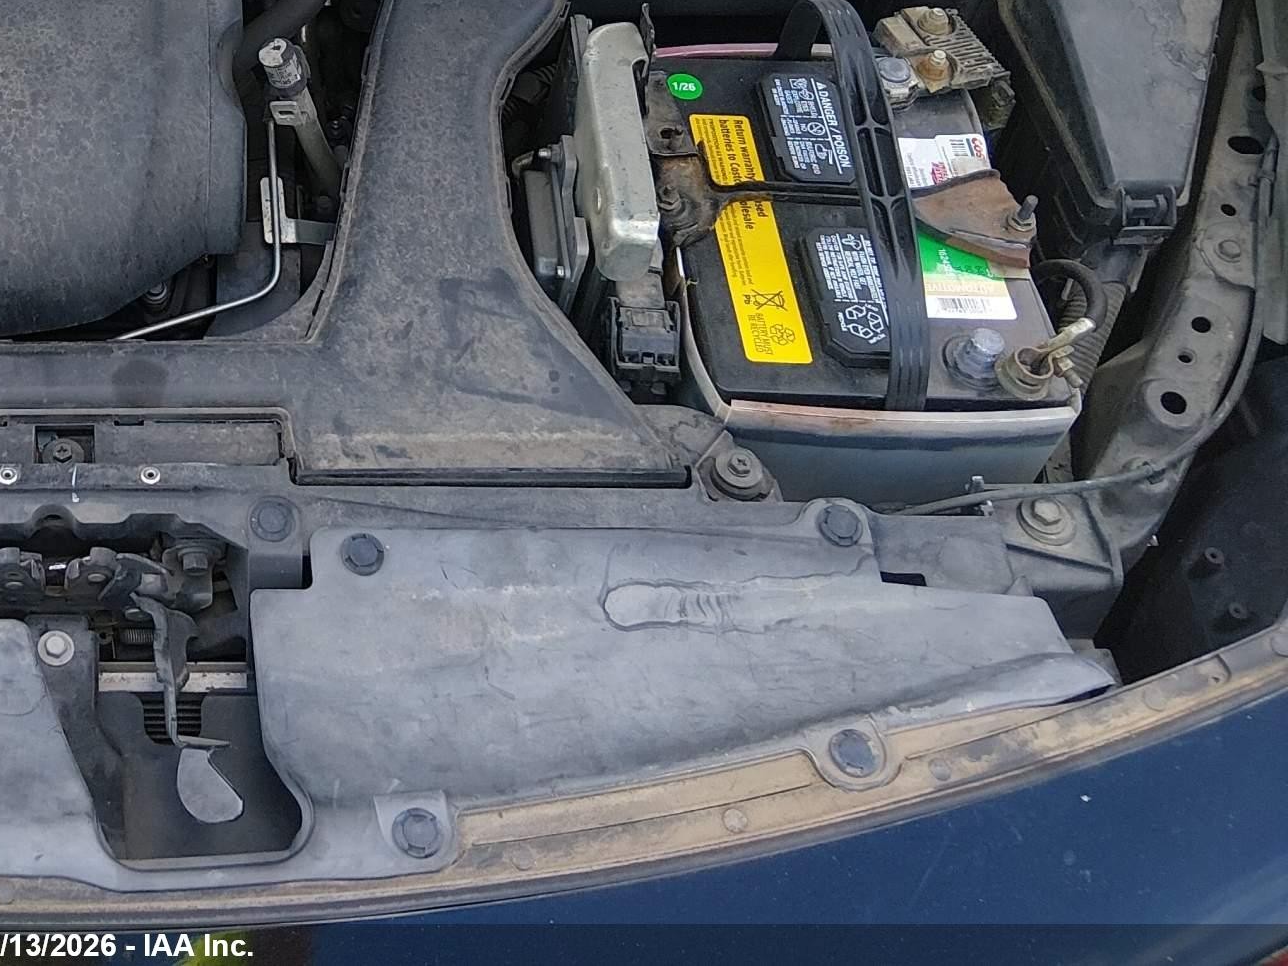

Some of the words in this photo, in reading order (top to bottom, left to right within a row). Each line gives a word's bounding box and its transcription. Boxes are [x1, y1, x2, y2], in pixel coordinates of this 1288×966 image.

[819, 90, 838, 126] DANGER
[832, 135, 852, 167] POISON
[733, 120, 747, 144] Return
[740, 147, 756, 178] warranty
[971, 138, 985, 159] COS
[719, 120, 735, 152] batteries
[739, 202, 756, 230] olesale
[743, 295, 752, 304] Pb
[749, 314, 757, 323] BE
[756, 313, 769, 338] BATTERY
[763, 339, 774, 355] MUST
[751, 324, 764, 353] RECYCLED
